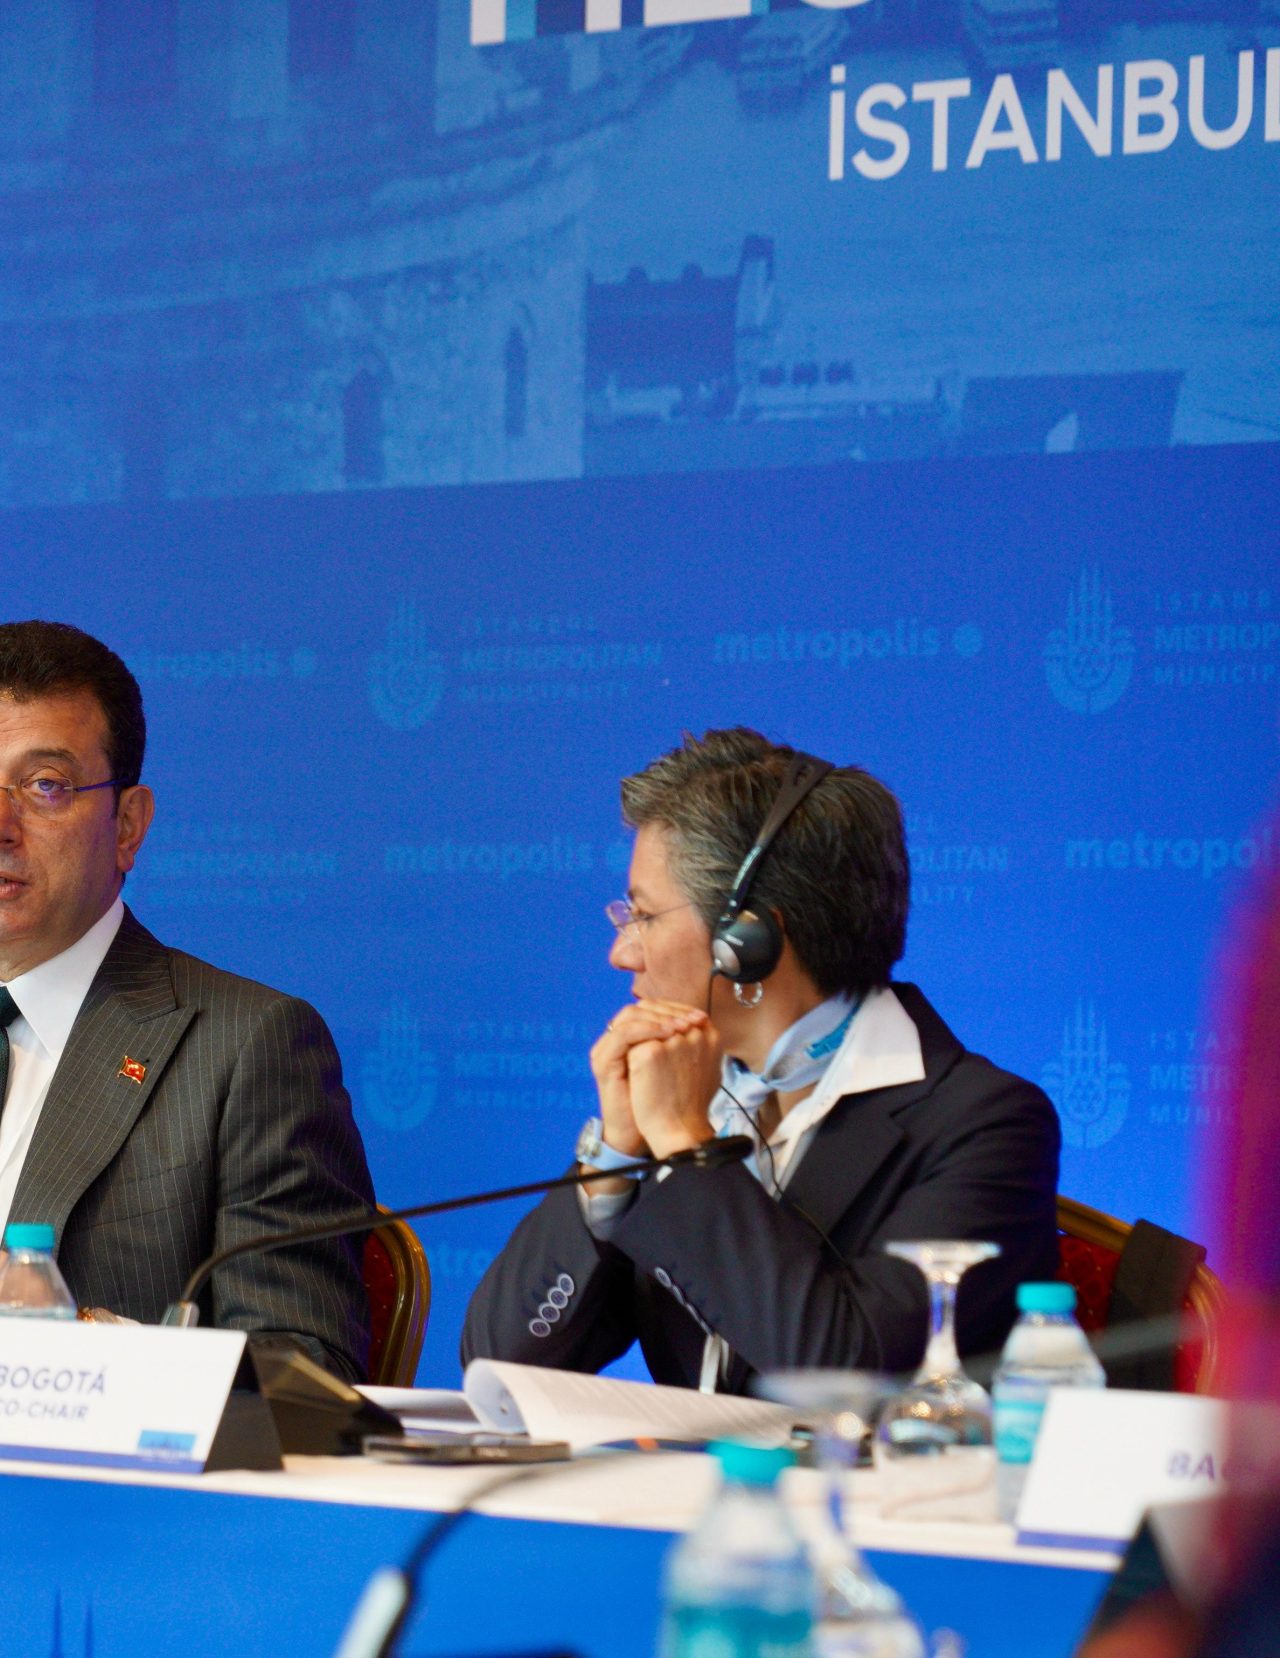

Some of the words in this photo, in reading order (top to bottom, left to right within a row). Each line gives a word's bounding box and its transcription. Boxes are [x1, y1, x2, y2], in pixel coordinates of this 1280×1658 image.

[460, 641, 663, 672] METROPOLITAN
[713, 619, 941, 669] metropolis
[383, 832, 594, 881] metropolis
